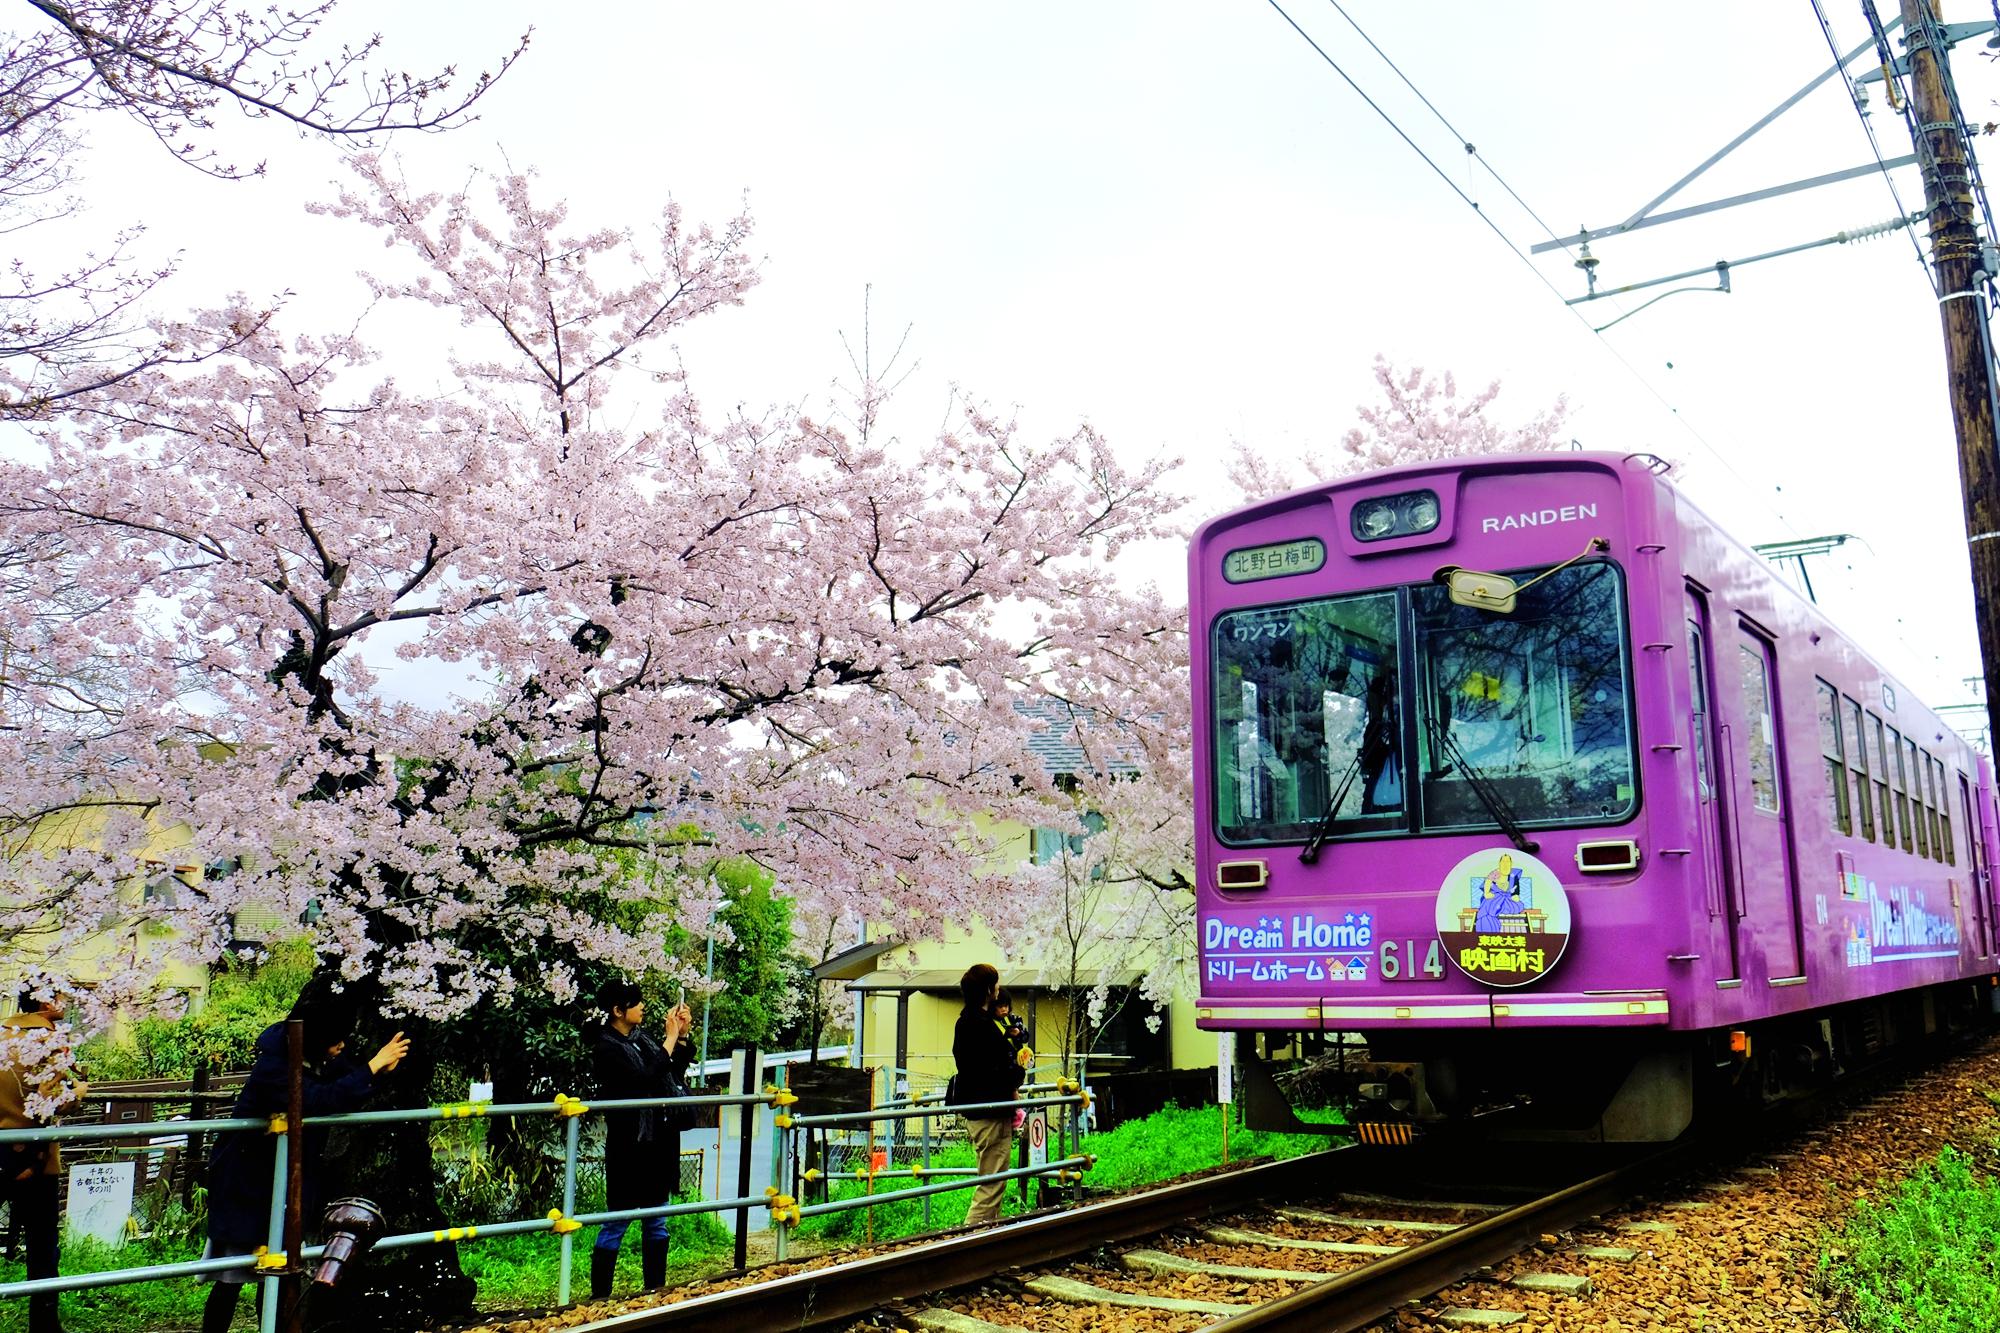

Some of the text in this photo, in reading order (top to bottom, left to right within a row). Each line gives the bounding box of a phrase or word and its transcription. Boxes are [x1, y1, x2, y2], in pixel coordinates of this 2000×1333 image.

[1482, 503, 1597, 533] RANDEN
[1234, 544, 1317, 574] 北野白梅町
[1234, 622, 1292, 642] ワンマン
[1205, 914, 1372, 950] Dream Home
[1207, 960, 1325, 982] ドリームホーム
[1380, 940, 1443, 979] 614
[1460, 947, 1545, 973] 映画村
